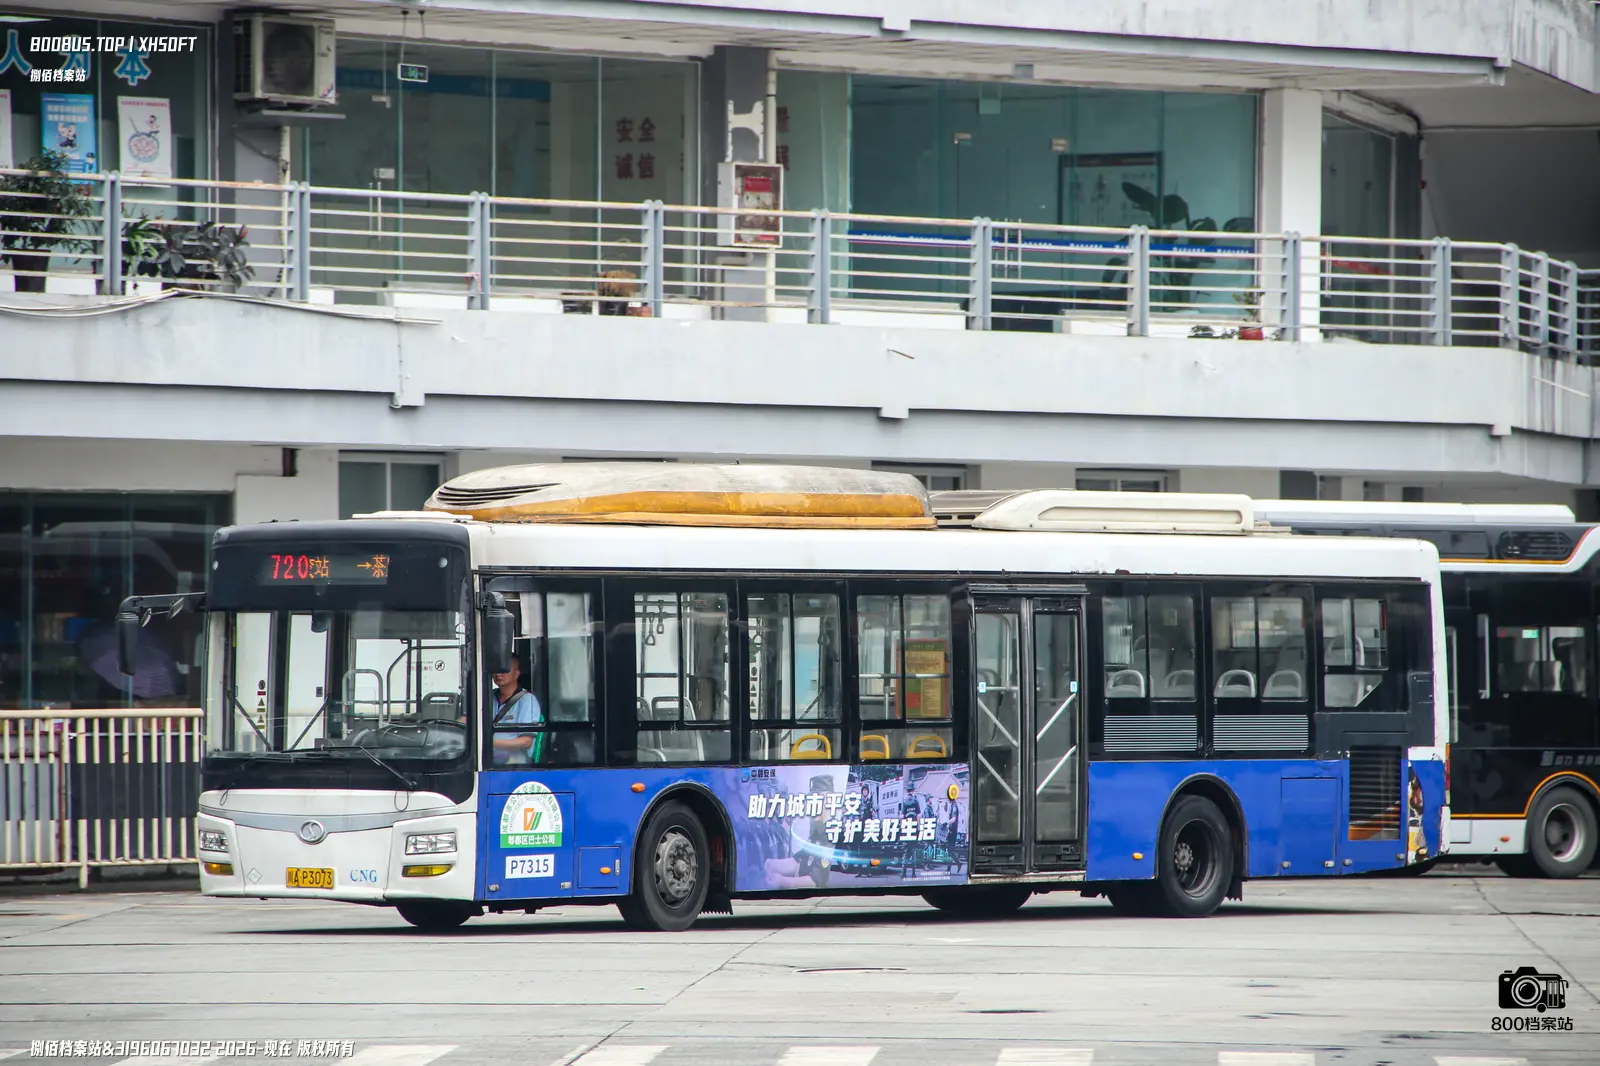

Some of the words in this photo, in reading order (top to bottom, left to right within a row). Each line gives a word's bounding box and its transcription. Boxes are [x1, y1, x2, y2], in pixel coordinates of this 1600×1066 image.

[616, 117, 656, 143] 安全
[271, 554, 309, 579] 720
[748, 792, 862, 819] 助力城市平安
[508, 834, 555, 846] 郫都区巴士公司
[825, 817, 938, 844] 守护美好生活
[350, 869, 378, 883] CNG
[510, 858, 549, 875] P7315
